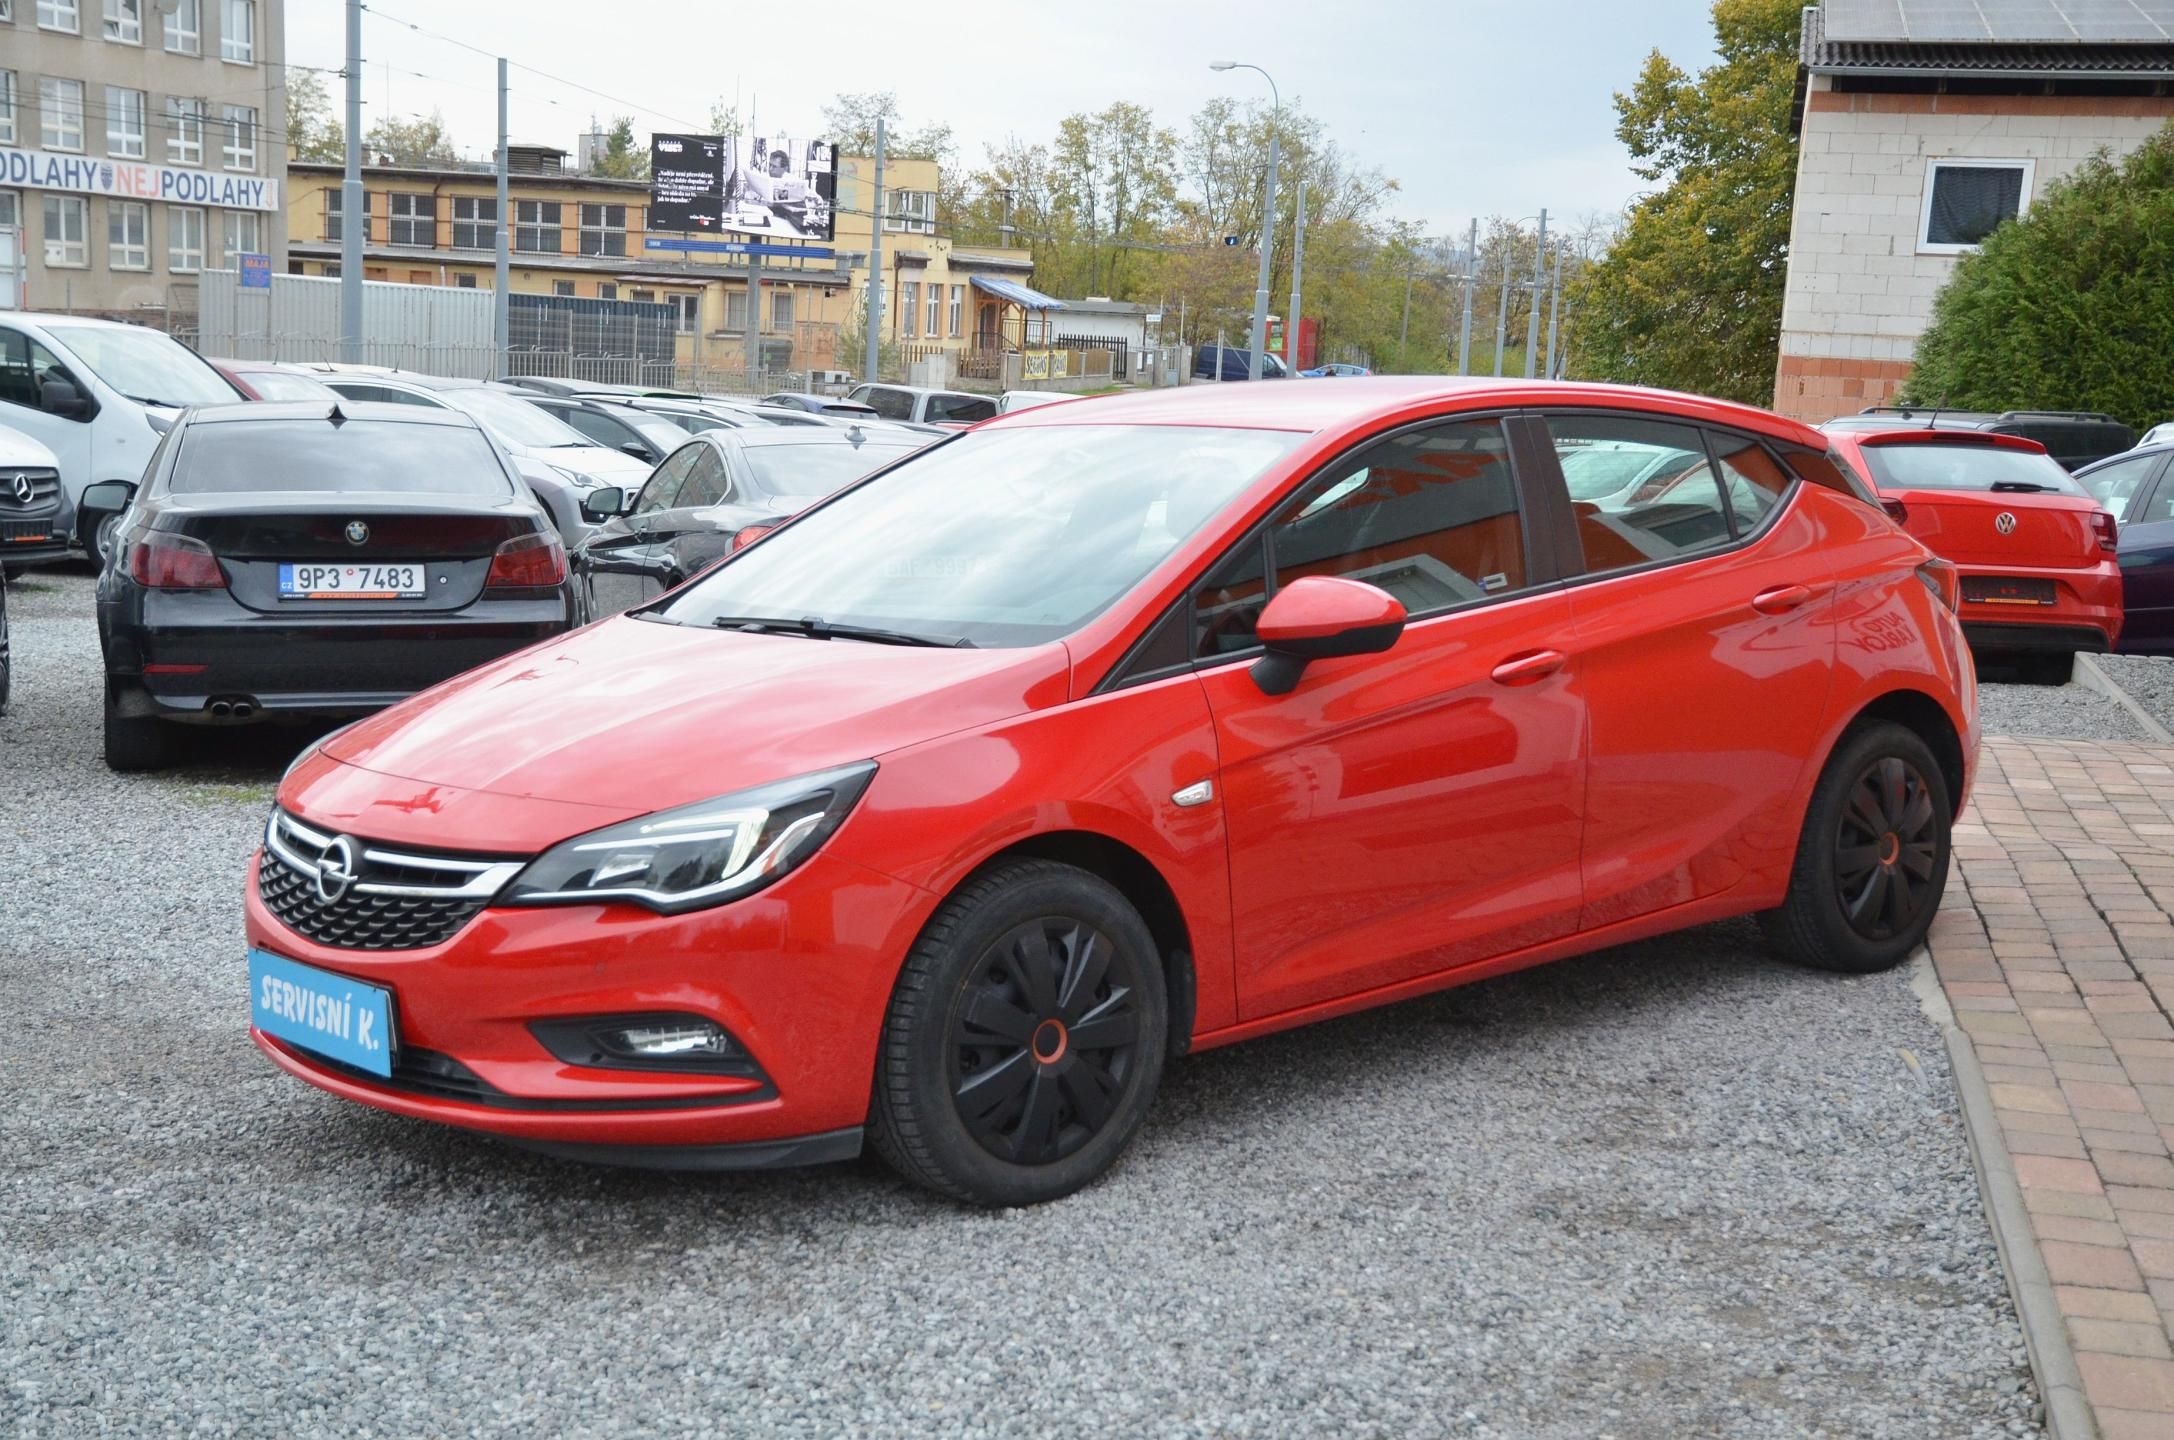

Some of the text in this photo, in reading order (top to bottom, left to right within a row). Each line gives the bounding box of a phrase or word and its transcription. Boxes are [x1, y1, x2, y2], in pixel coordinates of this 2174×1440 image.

[298, 567, 414, 589] 9P3 7483
[261, 974, 379, 1051] SERVISNÍ K.
